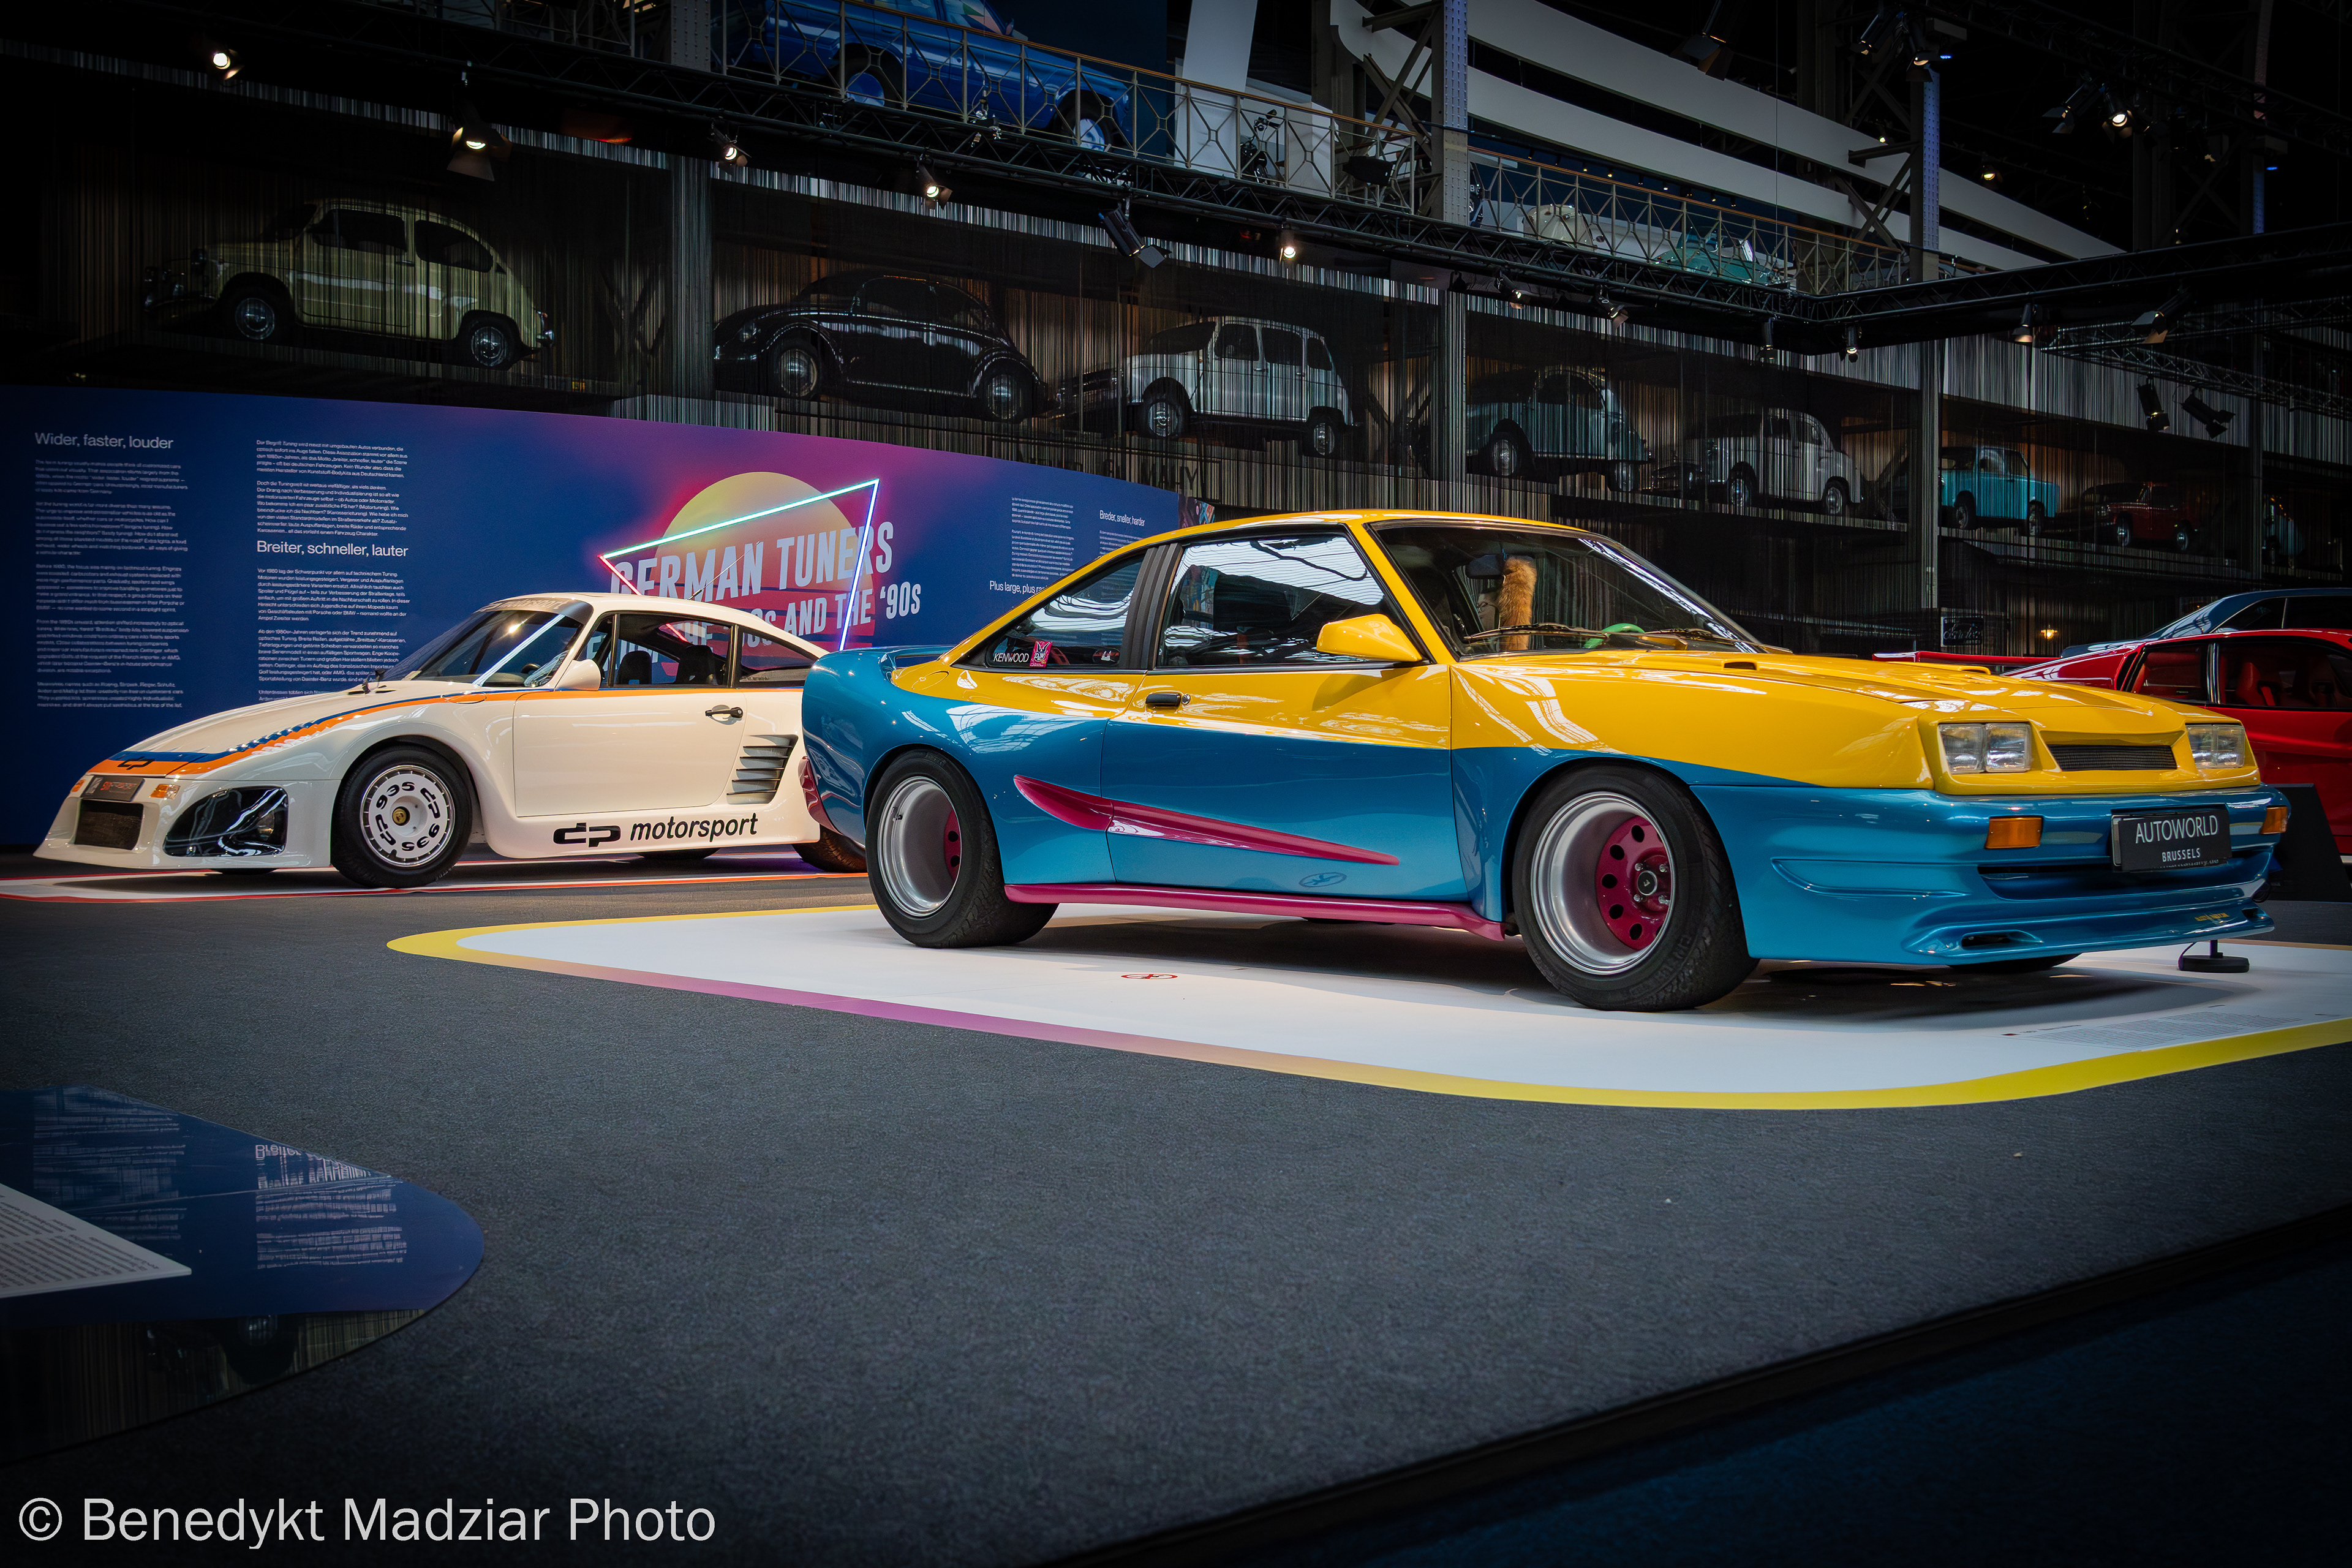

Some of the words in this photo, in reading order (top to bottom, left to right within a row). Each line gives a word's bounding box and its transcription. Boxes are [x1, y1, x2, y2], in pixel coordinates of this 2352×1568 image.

[35, 432, 80, 447] Wider,
[84, 434, 126, 449] faster,
[129, 435, 173, 449] louder
[1099, 510, 1117, 522] Breder,
[1117, 514, 1132, 525] sneller,
[1132, 516, 1145, 526] harder
[257, 540, 304, 554] Breiter,
[307, 543, 369, 557] schneller,
[372, 545, 409, 556] lauter
[610, 541, 763, 601] GERMAN
[777, 521, 894, 590] TUNERS
[989, 580, 1004, 591] Plus
[1005, 582, 1022, 594] large,
[1022, 584, 1035, 595] plus
[785, 597, 827, 636] AND
[835, 589, 873, 629] THE
[993, 652, 1029, 663] KENWOOD
[375, 781, 415, 810] 935
[552, 822, 621, 848] dp
[630, 813, 758, 843] motorsport
[2135, 815, 2218, 844] AUTOWORLD
[2162, 848, 2201, 862] BRUSSELS
